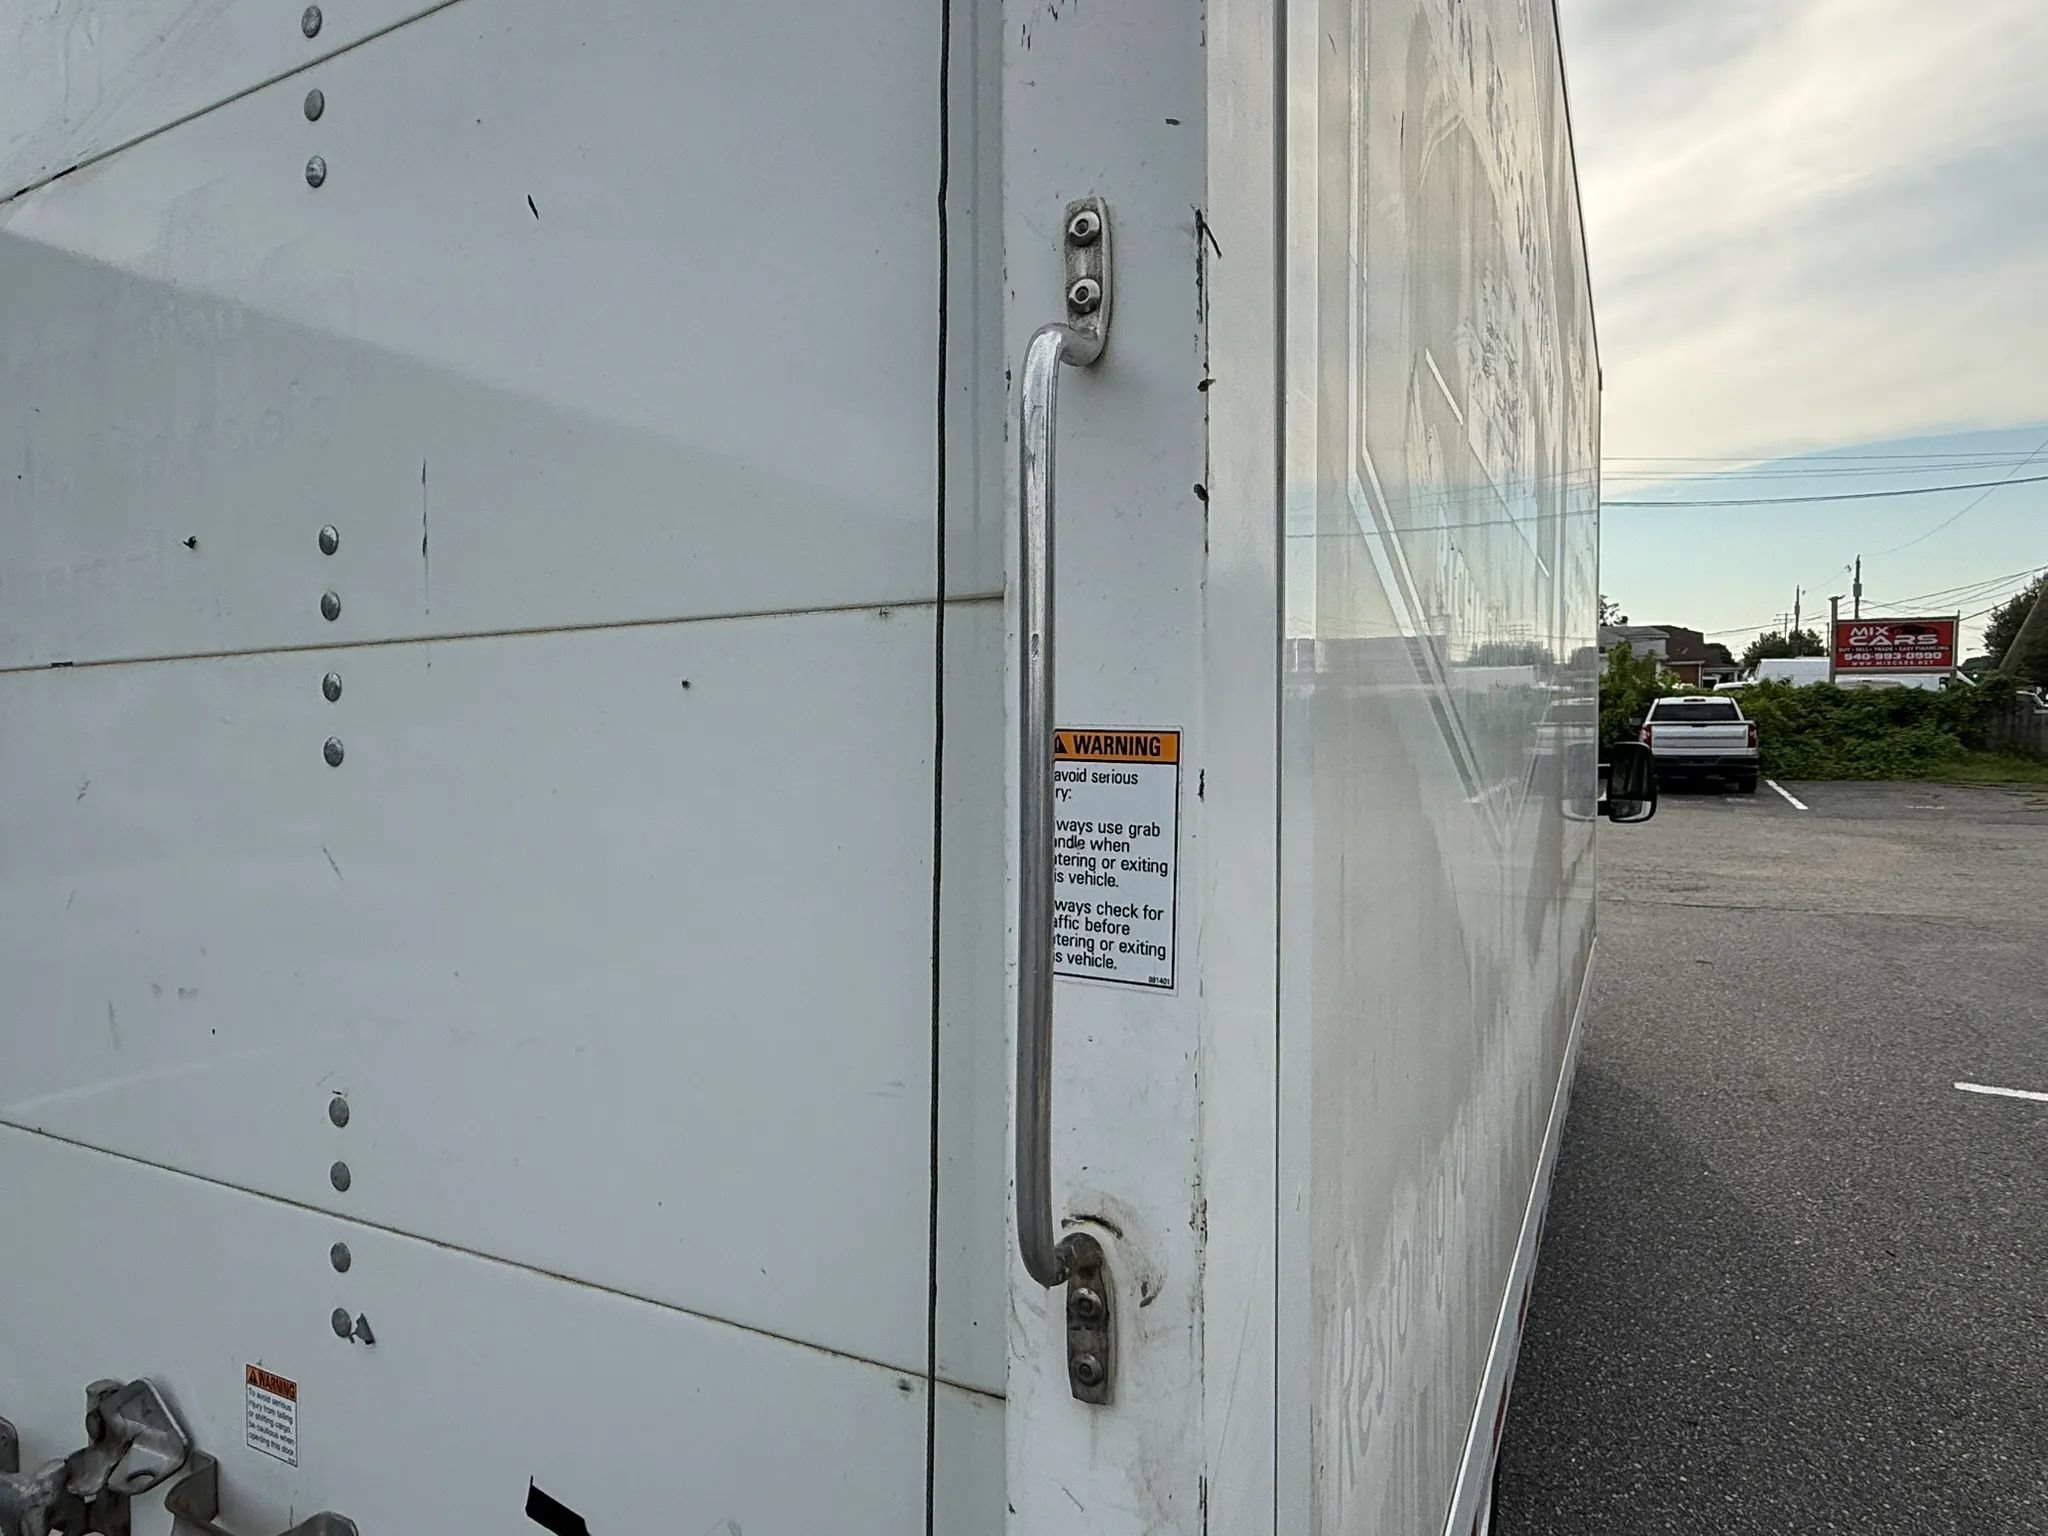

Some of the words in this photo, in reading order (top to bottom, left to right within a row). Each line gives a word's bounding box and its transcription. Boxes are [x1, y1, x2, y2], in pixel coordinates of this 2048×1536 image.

[1849, 634, 1938, 646] CARS
[1850, 626, 1889, 636] MIX
[1073, 735, 1161, 757] WARNING
[1054, 767, 1087, 783] avoid
[1091, 768, 1139, 785] serious
[1056, 819, 1093, 835] ways
[1098, 822, 1123, 834] use
[1128, 821, 1161, 839] grab
[1054, 835, 1085, 850] ndle
[1090, 837, 1130, 852] when
[1054, 852, 1096, 871] tering
[1101, 857, 1116, 869] or
[1121, 856, 1168, 877] exiting
[1068, 870, 1119, 888] vehicle.
[1054, 899, 1092, 916] ways
[1096, 901, 1139, 919] check
[1143, 904, 1164, 920] for
[1054, 914, 1079, 930] ffic
[1085, 917, 1130, 935] before
[1054, 932, 1095, 953] tering
[1099, 939, 1114, 951] or
[1119, 939, 1166, 961] exiting
[1066, 952, 1117, 971] vehicle.
[259, 1372, 295, 1399] WARNING
